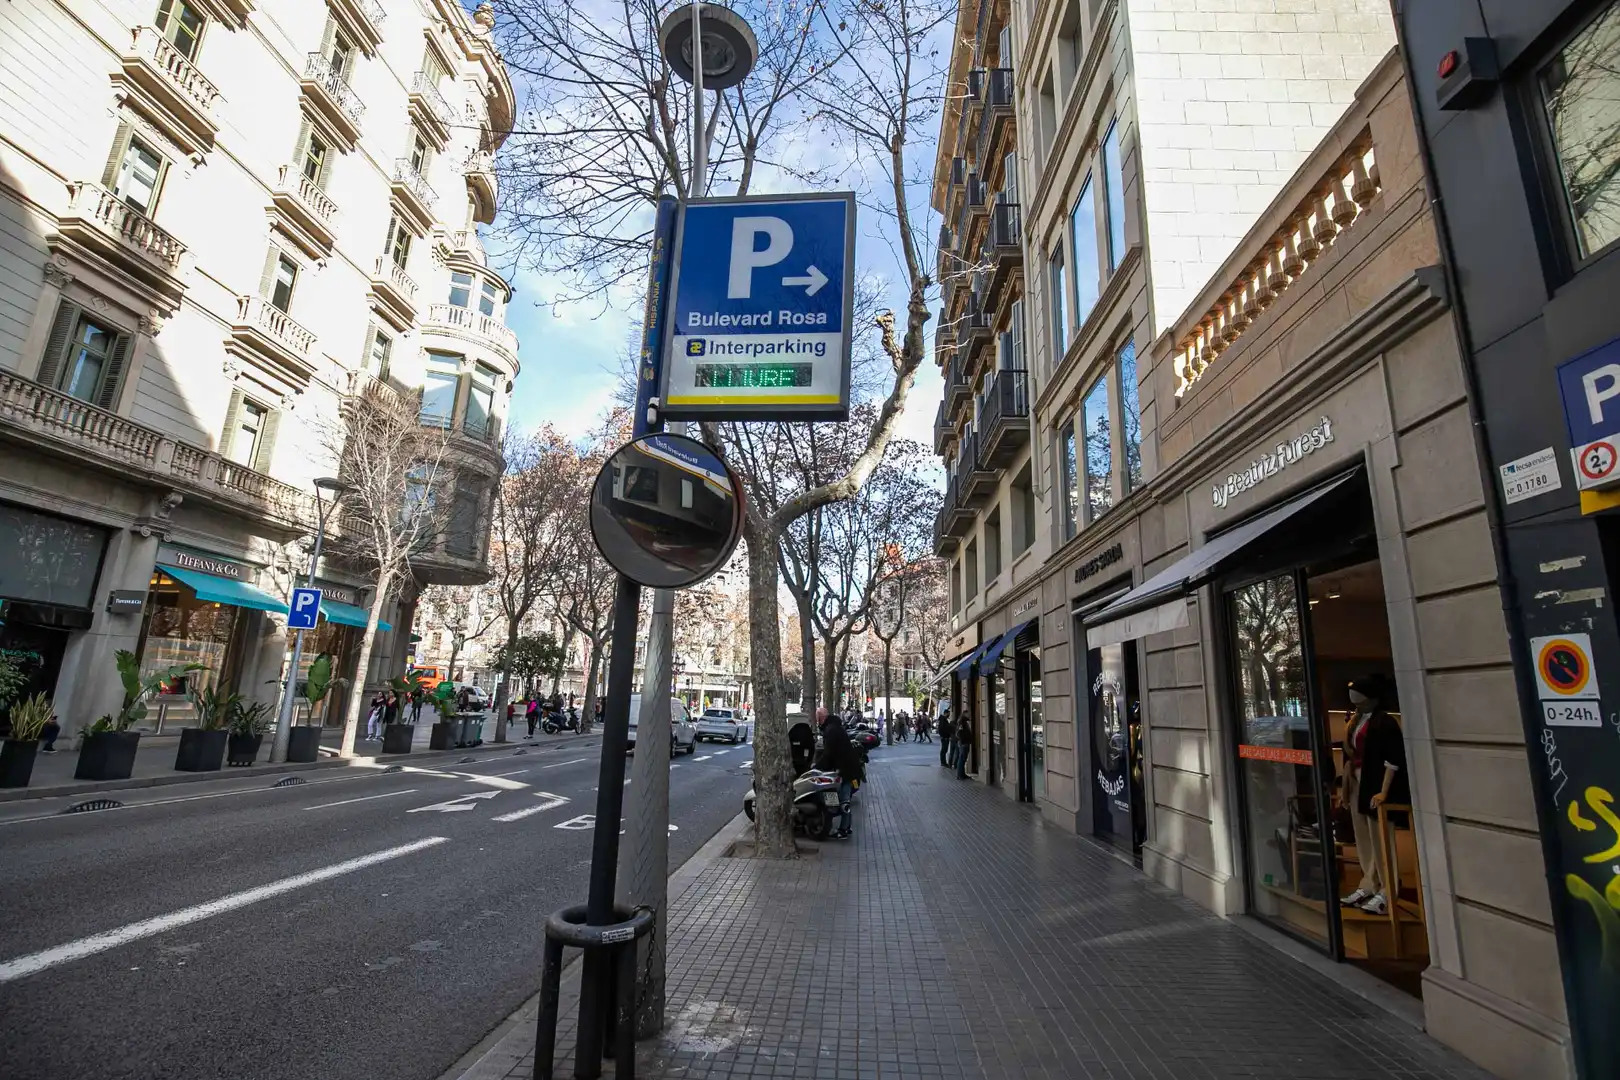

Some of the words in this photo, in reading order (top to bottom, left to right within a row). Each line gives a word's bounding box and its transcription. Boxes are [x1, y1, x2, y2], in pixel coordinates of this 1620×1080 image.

[728, 216, 794, 299] P
[688, 311, 772, 327] Bulevard
[778, 310, 827, 325] Rosa
[709, 339, 826, 357] Interparking
[1582, 363, 1620, 425] P
[295, 592, 315, 612] P
[1097, 769, 1125, 796] REBAJAS
